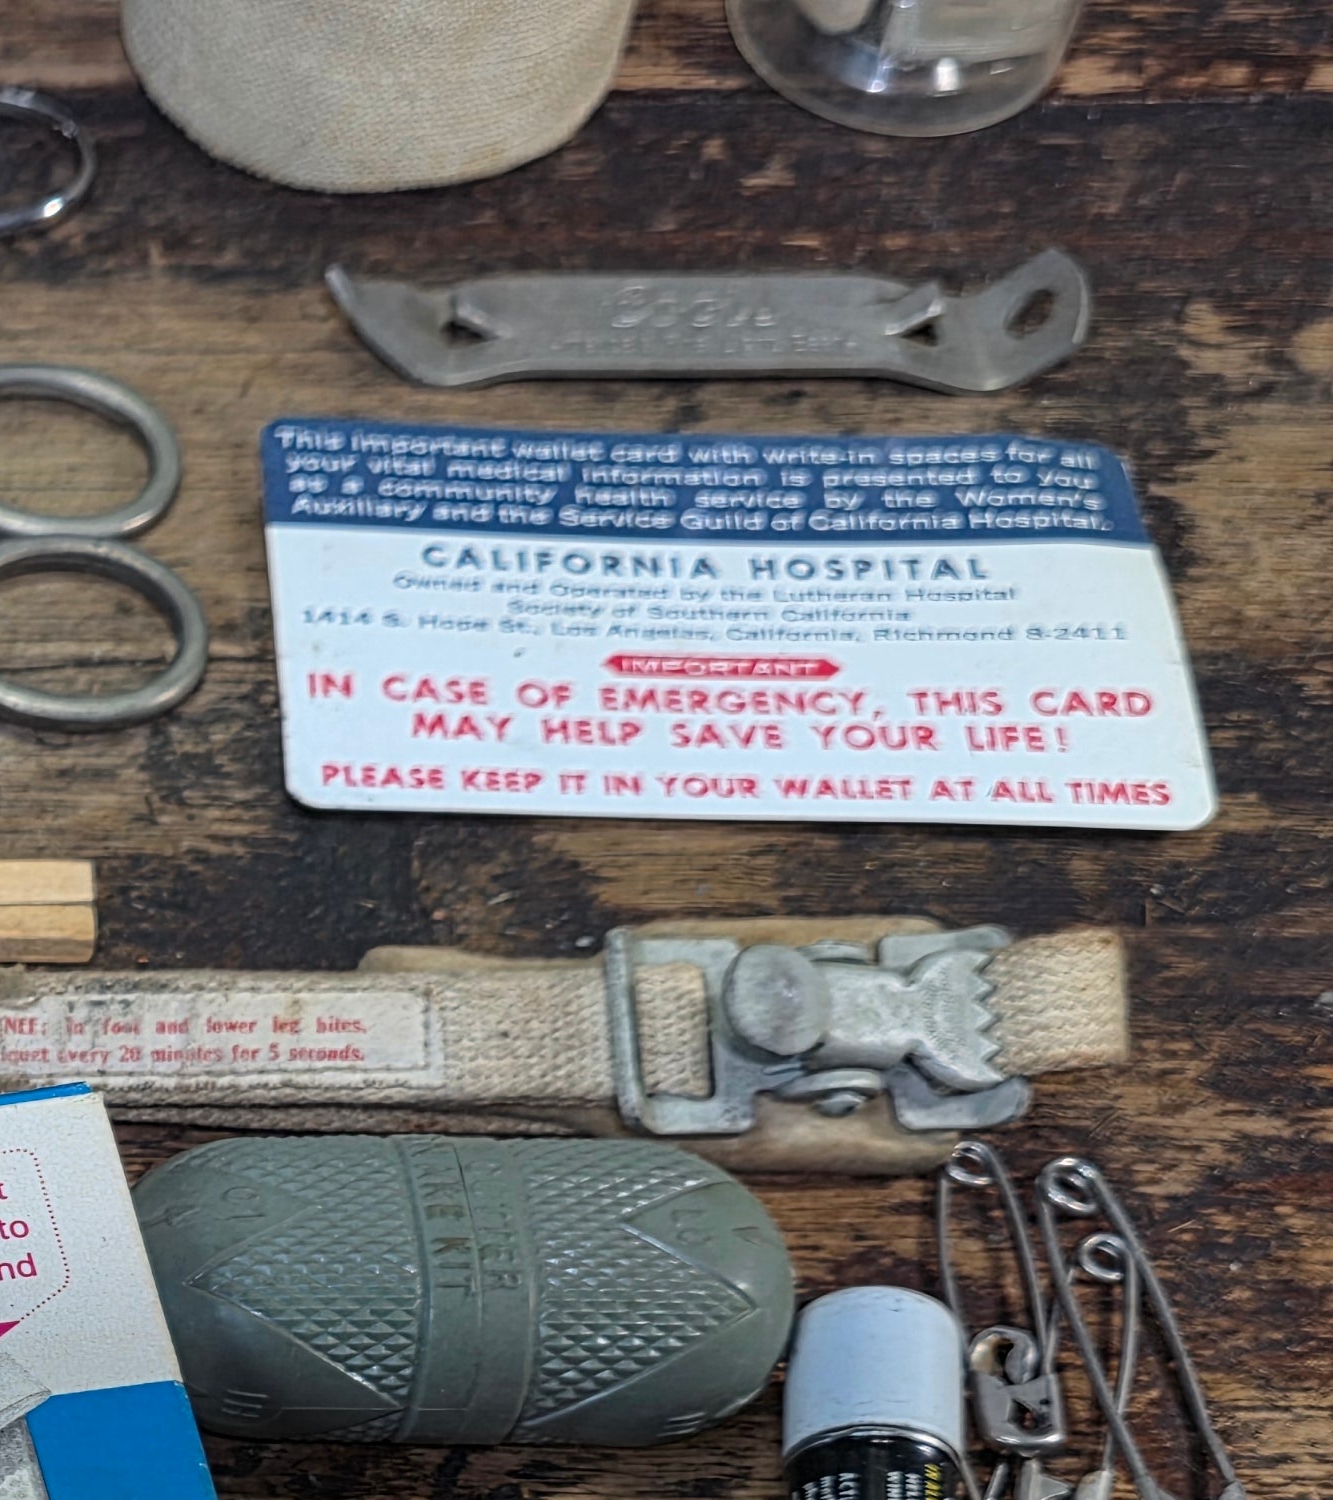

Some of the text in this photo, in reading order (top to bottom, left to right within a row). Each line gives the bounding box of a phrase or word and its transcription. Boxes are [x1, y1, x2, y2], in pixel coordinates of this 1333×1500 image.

[274, 426, 345, 451] This
[351, 431, 507, 459] important
[511, 440, 606, 463] wallet
[610, 442, 683, 463] card
[688, 442, 758, 464] with
[888, 442, 1002, 466] spaces
[1005, 440, 1056, 463] for
[1060, 443, 1100, 469] all
[285, 454, 1100, 490] your vital medical information is presented to you
[378, 478, 1107, 510] community health service by the Women's
[291, 494, 965, 531] Auxiliary and the Service Guild of California
[421, 545, 991, 581] CALIFORNIA HOSPITAL
[721, 587, 1015, 603] the Lutheran Hospital
[302, 608, 371, 625] 1414
[873, 625, 1013, 641] Richmond
[781, 607, 911, 622] California
[620, 658, 820, 677] IMPORTANT
[306, 672, 1152, 721] IN CASE OF EMERGENCY, THIS CARD
[412, 712, 513, 742] MAY
[542, 718, 642, 745] HELP
[670, 720, 783, 751] SAVE
[811, 724, 938, 752] YOUR
[322, 763, 1170, 806] PLEASE KEEP IT IN YOUR WALLET AT ALL TIMES
[155, 1019, 188, 1034] and
[206, 1016, 257, 1033] lower
[272, 1017, 302, 1035] leg
[316, 1016, 367, 1034] bites.
[119, 1046, 141, 1062] 20
[231, 1045, 259, 1062] for
[269, 1042, 279, 1061] 5
[287, 1045, 364, 1062] seconds.
